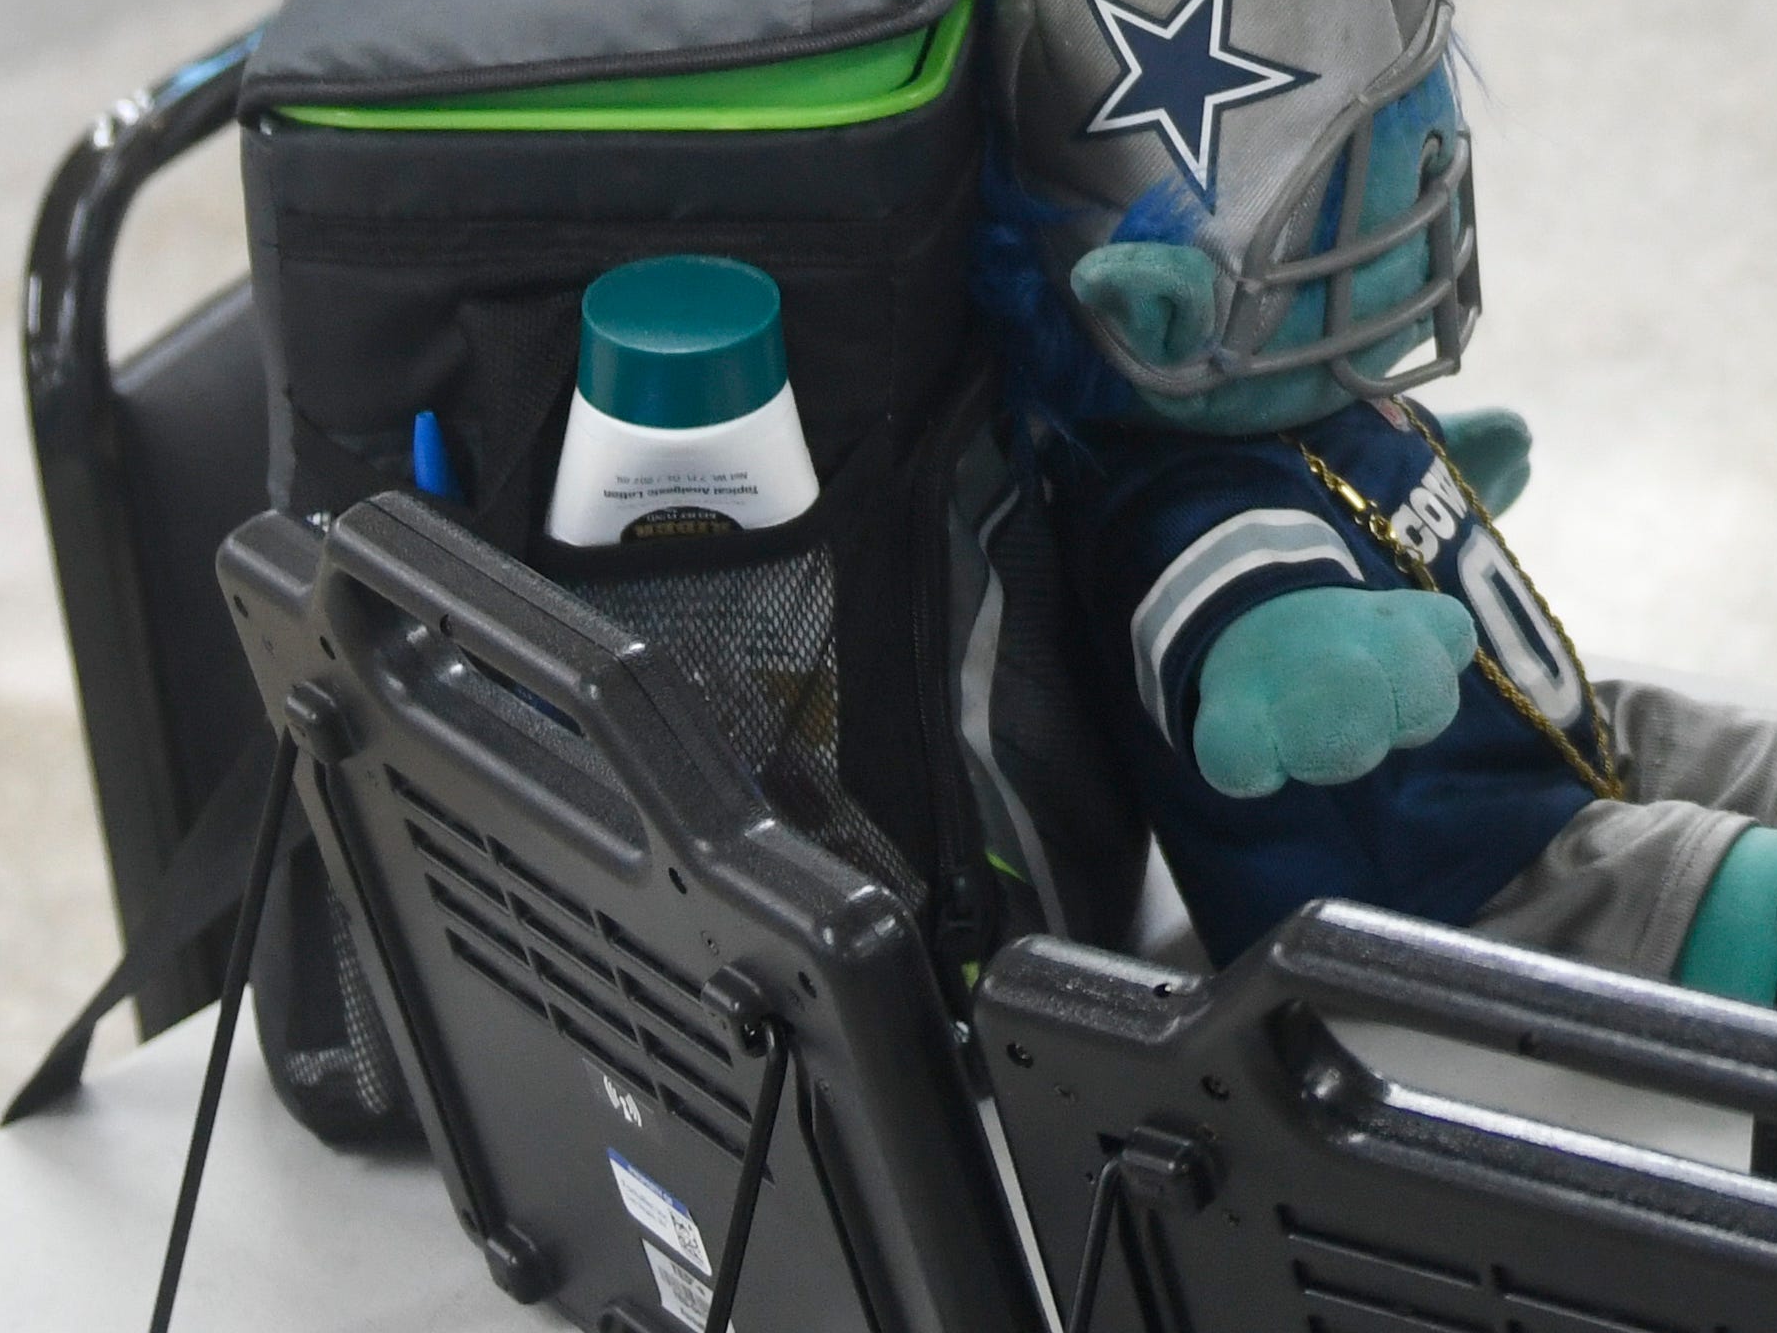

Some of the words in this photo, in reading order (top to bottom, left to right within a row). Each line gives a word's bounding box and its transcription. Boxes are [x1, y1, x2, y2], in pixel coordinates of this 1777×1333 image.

[603, 489, 644, 500] Lotion
[647, 485, 711, 497] Analgesic
[713, 485, 759, 496] Topical
